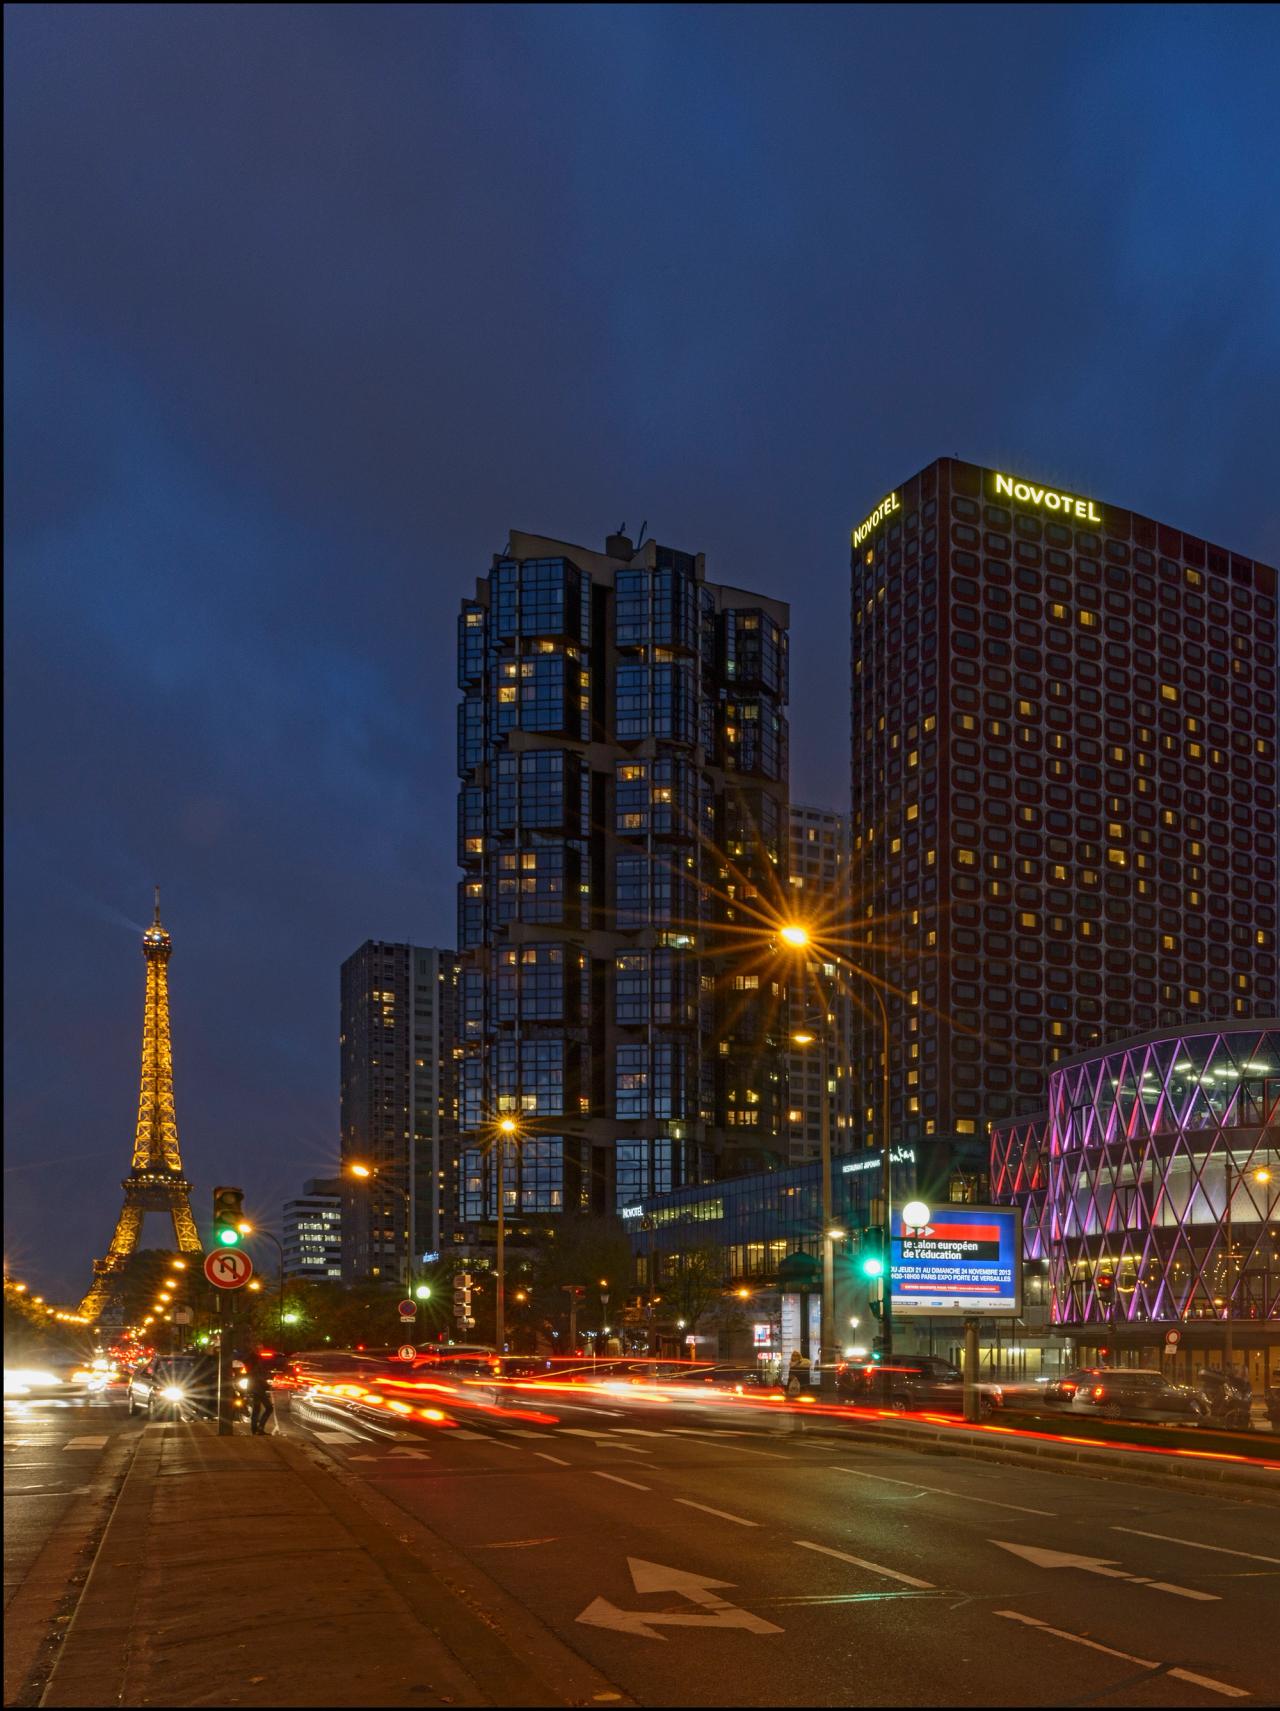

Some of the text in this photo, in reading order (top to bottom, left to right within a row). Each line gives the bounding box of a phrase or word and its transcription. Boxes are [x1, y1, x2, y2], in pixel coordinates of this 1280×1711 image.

[995, 473, 1101, 522] NOVOTEL
[852, 492, 900, 548] NOVOTEL
[622, 1205, 644, 1219] NOVOTEL
[938, 1241, 978, 1251] européen
[903, 1249, 914, 1258] de
